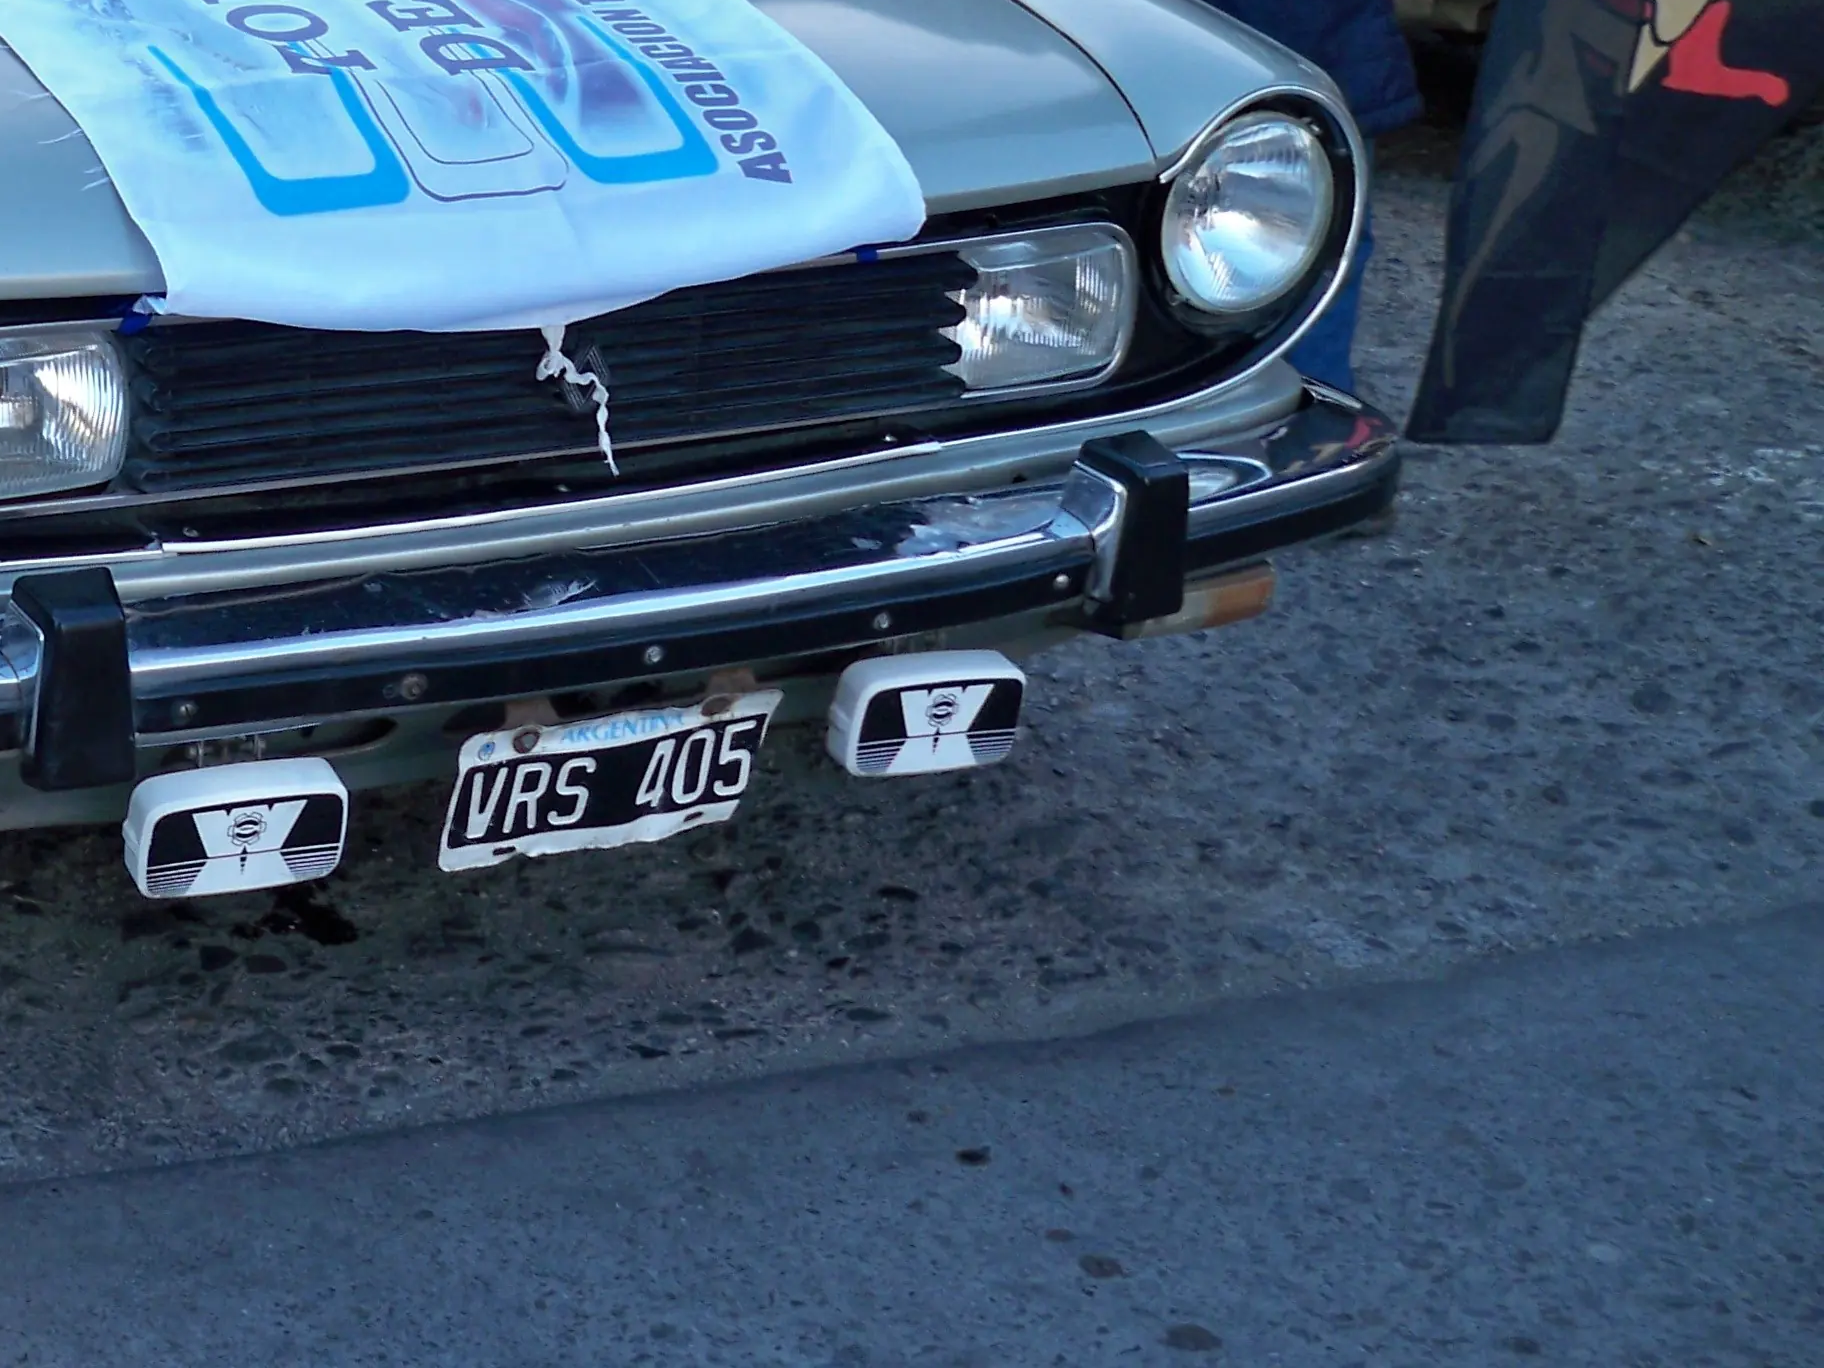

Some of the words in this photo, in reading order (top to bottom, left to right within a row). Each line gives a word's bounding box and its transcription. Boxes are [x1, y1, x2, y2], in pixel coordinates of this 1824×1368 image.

[591, 8, 794, 184] ASOCIACION
[464, 757, 597, 840] VRS
[634, 719, 758, 808] 405
